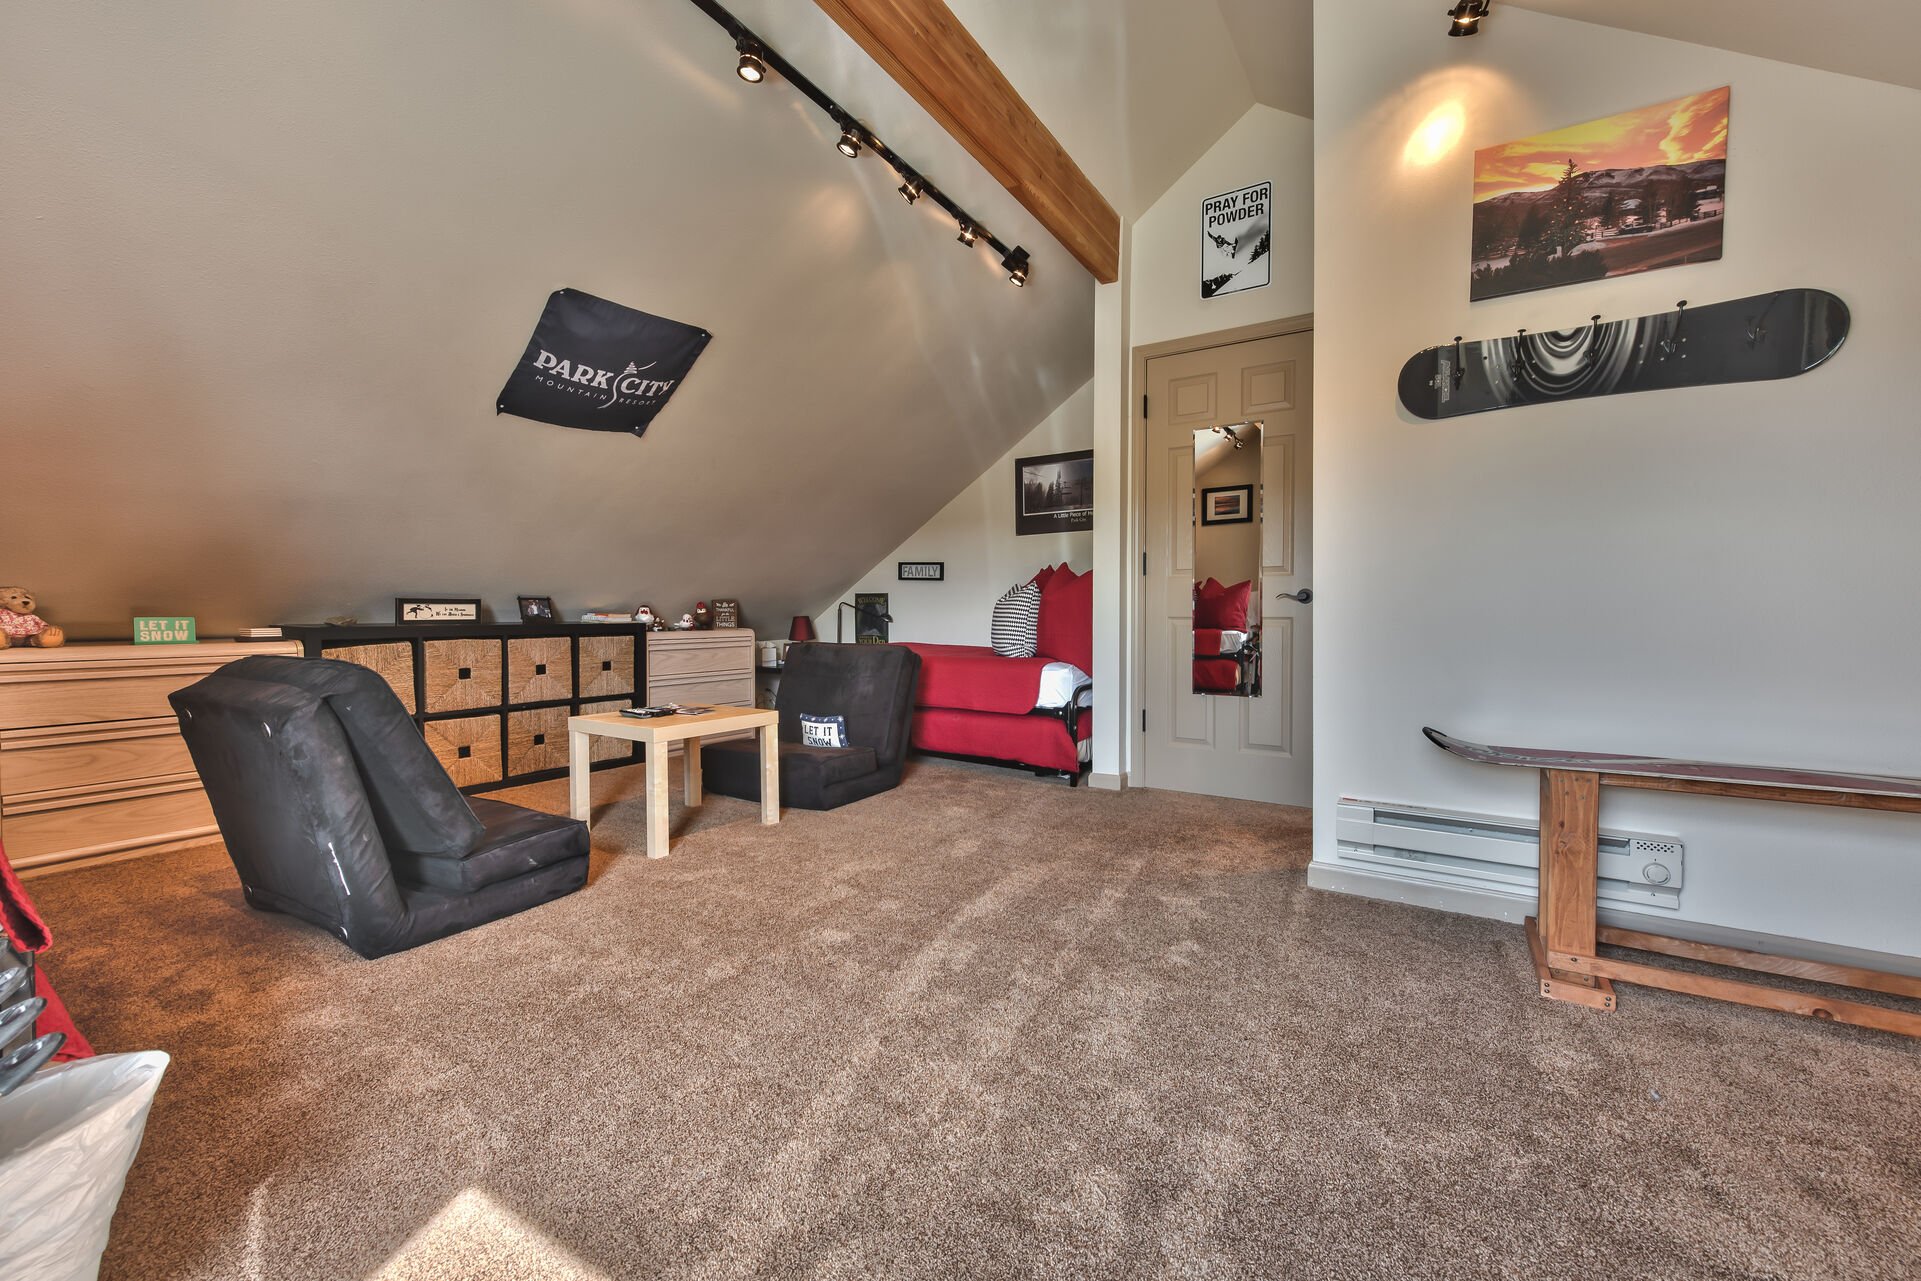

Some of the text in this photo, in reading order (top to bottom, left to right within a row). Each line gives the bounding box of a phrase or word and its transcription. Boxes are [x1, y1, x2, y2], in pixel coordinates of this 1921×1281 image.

[1205, 187, 1268, 215] PRAY FOR
[1208, 203, 1264, 228] POWDER
[533, 349, 675, 397] PARK CITY
[535, 375, 656, 406] MOUNTAIN RESORT
[902, 565, 938, 577] FAMILY
[139, 620, 190, 631] LET IT
[140, 630, 189, 641] SNOW
[804, 724, 833, 737] LET IT
[807, 736, 832, 747] SNOW
